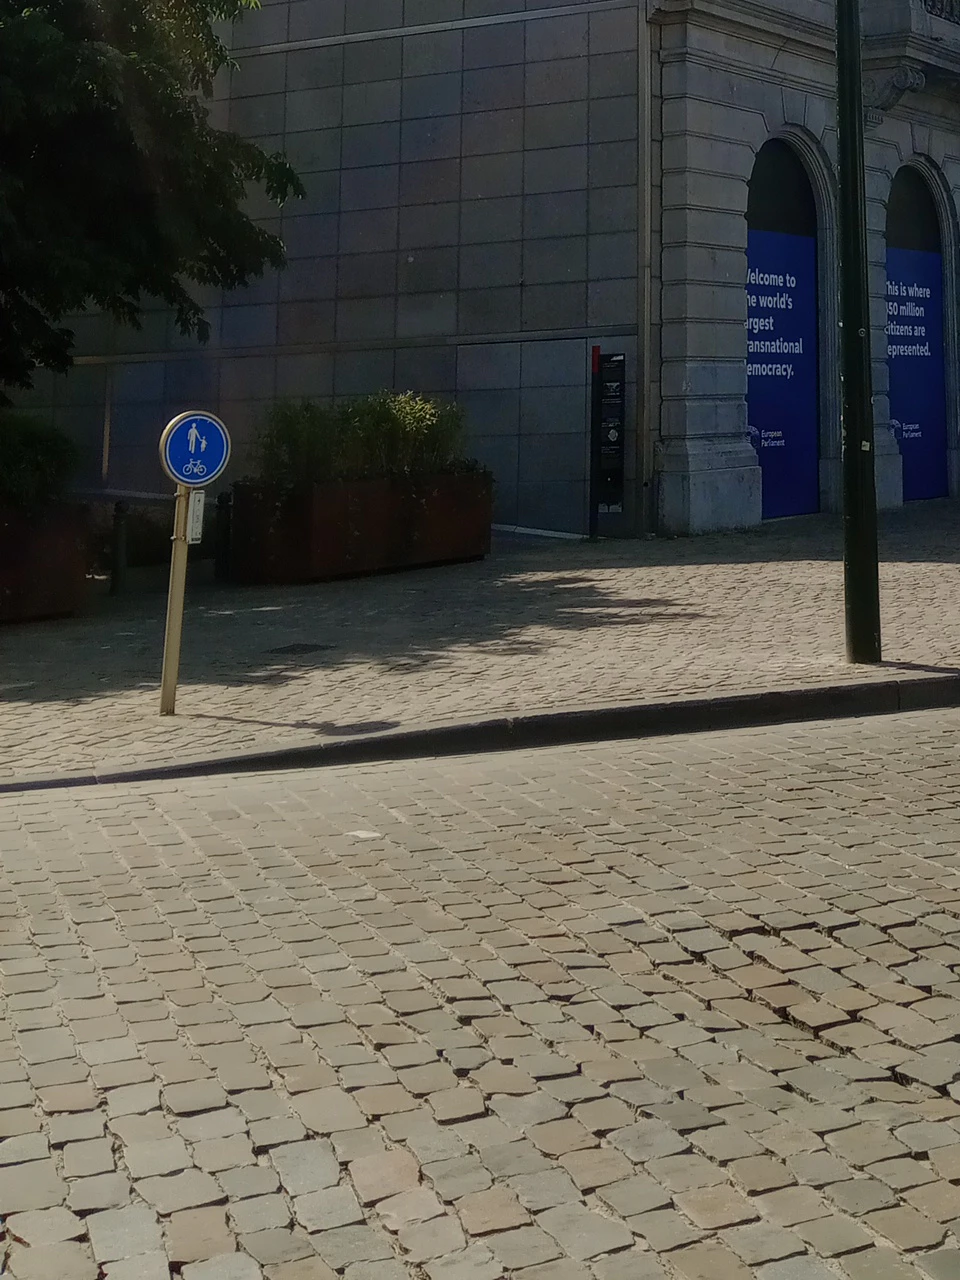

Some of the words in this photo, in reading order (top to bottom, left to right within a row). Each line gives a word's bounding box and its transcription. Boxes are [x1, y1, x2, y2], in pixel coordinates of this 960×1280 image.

[747, 268, 784, 286] elcome
[786, 273, 796, 288] to
[900, 282, 907, 296] is
[908, 283, 931, 298] where
[746, 291, 757, 307] he
[759, 292, 793, 309] world's
[899, 302, 925, 317] million
[744, 316, 774, 333] argest
[884, 321, 912, 336] citizens
[914, 325, 926, 336] are
[747, 337, 803, 354] ansnational
[887, 342, 931, 359] epresented.
[745, 361, 794, 380] emocracy.
[761, 429, 782, 438] European
[761, 439, 785, 447] Parliament
